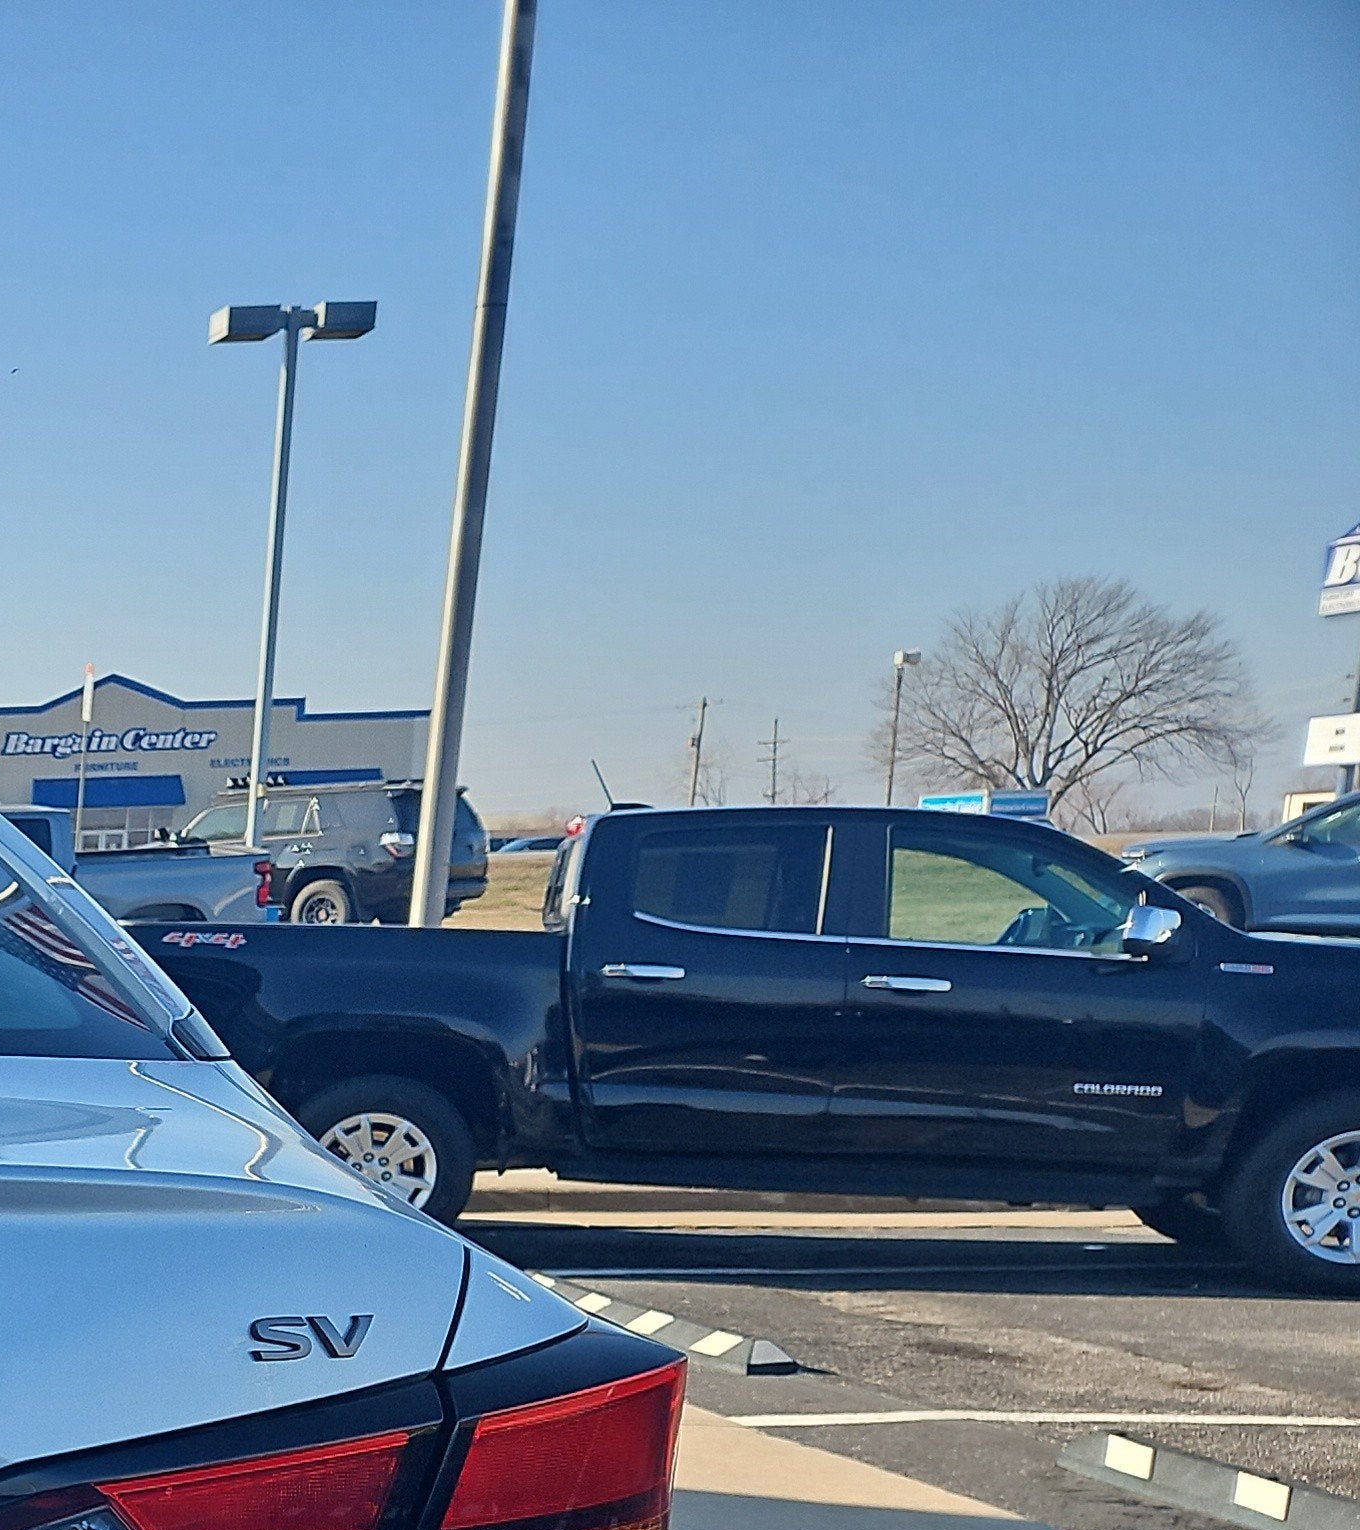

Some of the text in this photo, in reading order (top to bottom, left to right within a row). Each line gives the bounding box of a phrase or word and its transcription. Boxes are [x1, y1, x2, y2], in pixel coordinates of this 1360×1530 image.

[1323, 543, 1360, 588] B
[1, 727, 218, 759] Bargain Center
[209, 757, 290, 769] ELECTICS
[1072, 1082, 1164, 1098] COLORADO
[250, 1313, 375, 1362] SV
